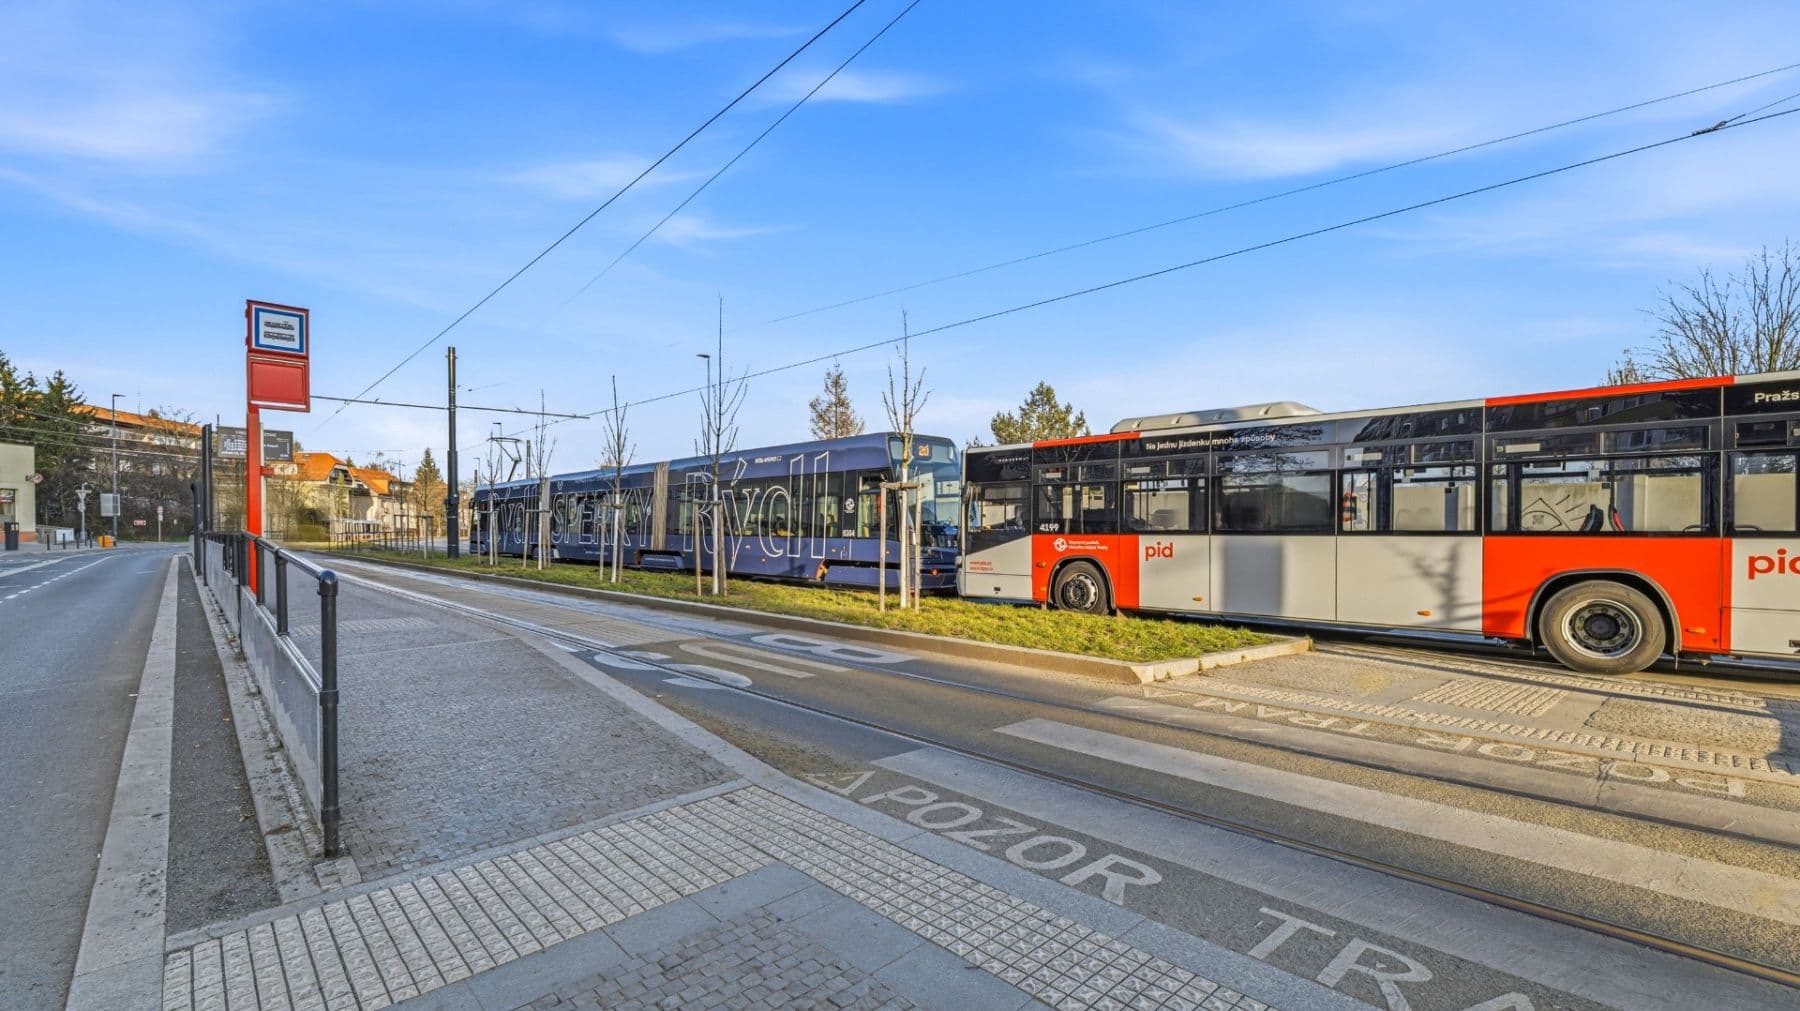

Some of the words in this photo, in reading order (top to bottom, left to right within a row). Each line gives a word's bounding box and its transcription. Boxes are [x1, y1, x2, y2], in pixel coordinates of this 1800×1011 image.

[1145, 442, 1156, 450] Na
[1157, 441, 1178, 451] jednu
[1039, 522, 1060, 532] 4199
[1145, 541, 1173, 561] pid
[858, 784, 1163, 906] POZOR
